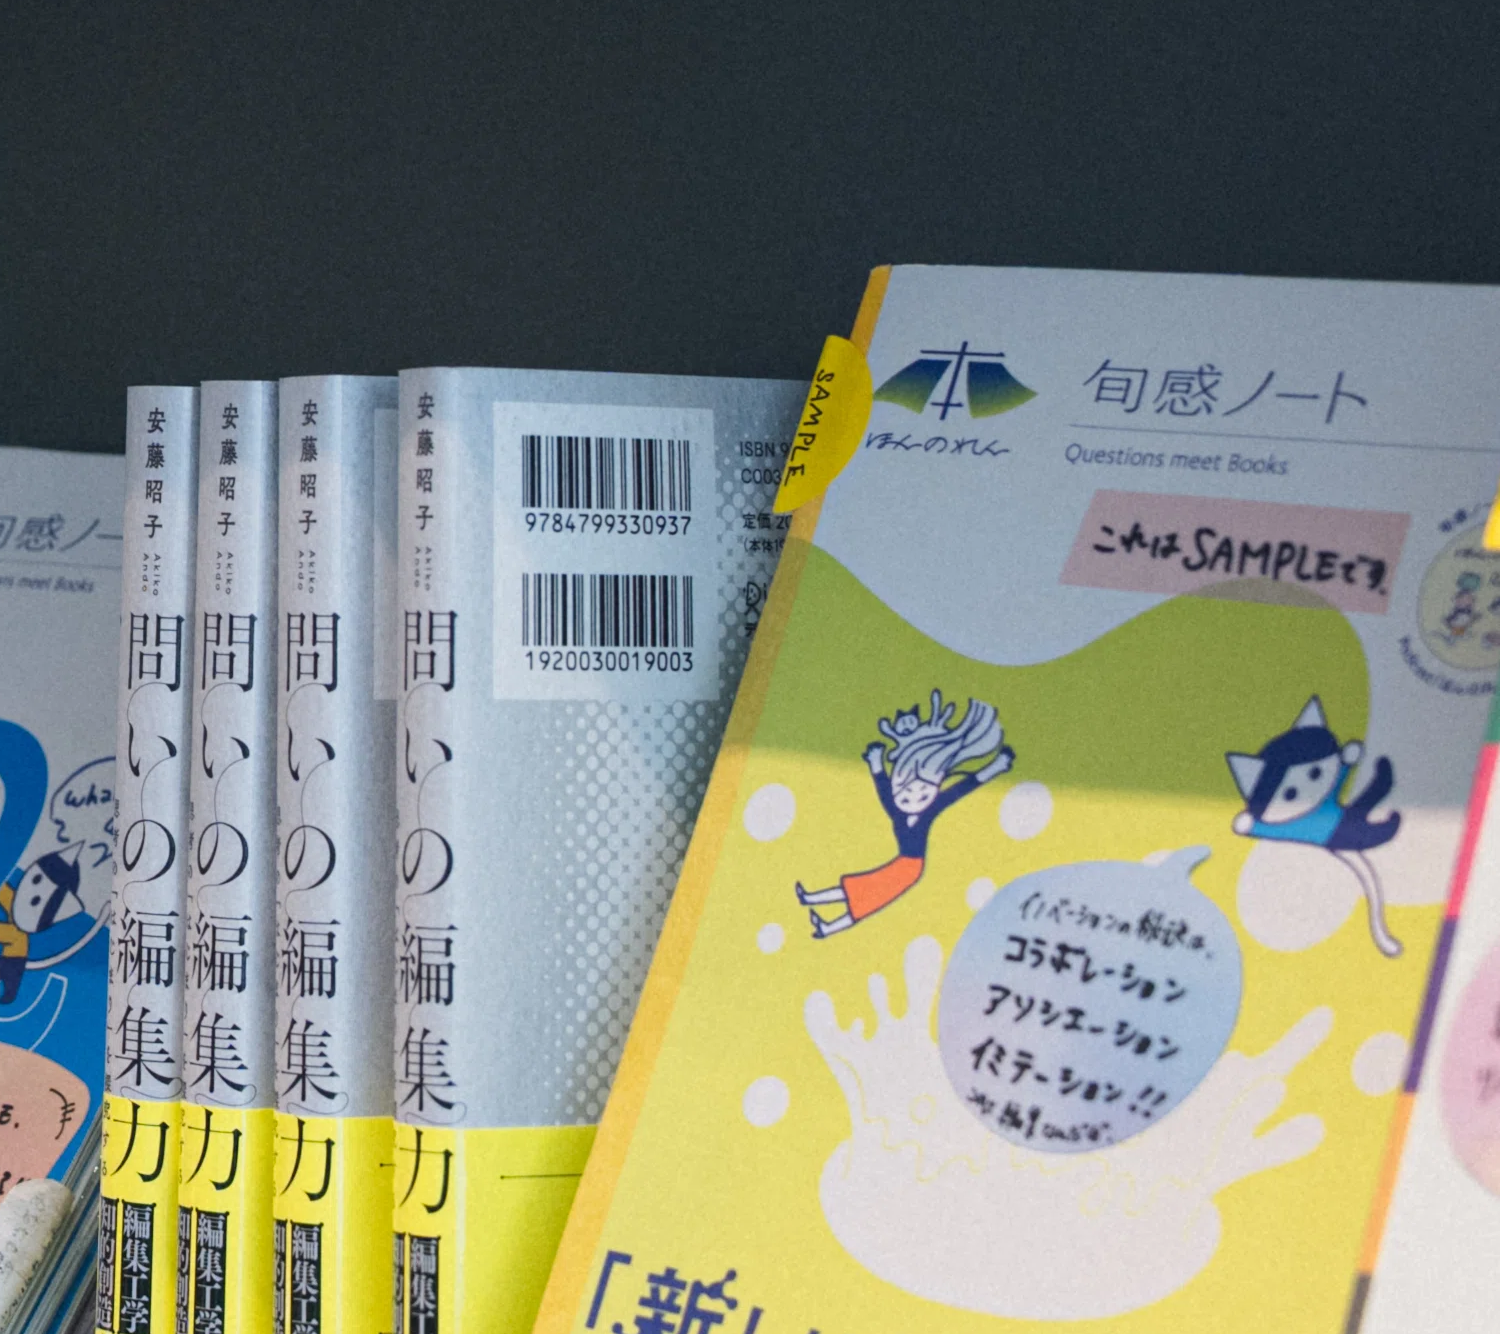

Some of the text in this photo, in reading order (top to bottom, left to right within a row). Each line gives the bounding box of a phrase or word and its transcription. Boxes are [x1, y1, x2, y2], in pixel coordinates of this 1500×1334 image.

[784, 366, 835, 490] SAMPLE
[1083, 356, 1368, 427] 旬感ノート
[144, 406, 168, 539] 安藤昭子
[216, 402, 240, 538] 安藤昭子
[301, 398, 319, 536] 安藤昭子
[415, 391, 435, 531] 安藤昭子
[739, 442, 776, 458] ISBN
[740, 469, 782, 484] C003
[865, 431, 1011, 458] ほんのれん
[1064, 442, 1289, 477] Questions meet Books
[524, 513, 692, 535] 9784799330937
[20, 574, 50, 589] meet
[54, 576, 94, 593] Books
[525, 651, 694, 672] 1920030019003
[113, 611, 186, 1184] 問いの編集力
[185, 611, 258, 1191] 問いの編集力
[279, 610, 342, 1202] 問いの編集力
[399, 609, 460, 1213] 問いの編集力
[1004, 935, 1186, 1003] コラボレーション
[984, 984, 1179, 1061] アソシエーション
